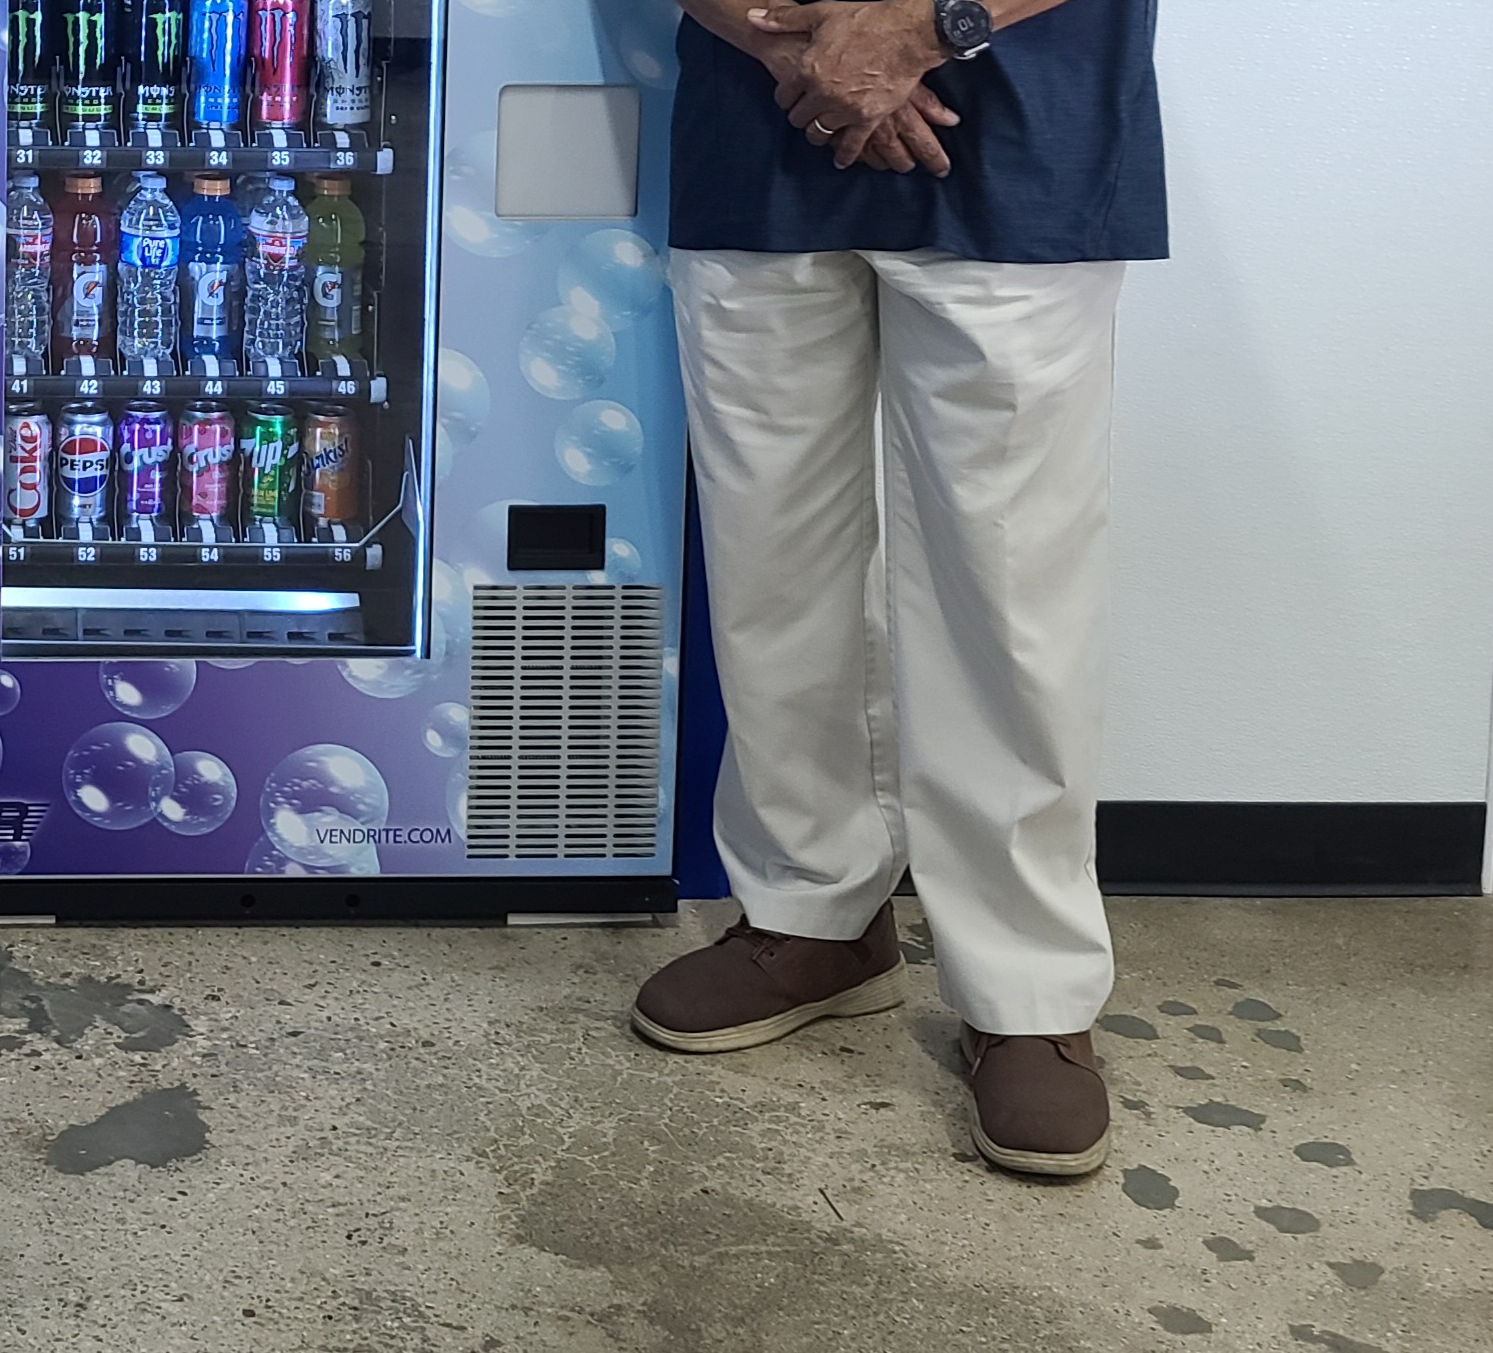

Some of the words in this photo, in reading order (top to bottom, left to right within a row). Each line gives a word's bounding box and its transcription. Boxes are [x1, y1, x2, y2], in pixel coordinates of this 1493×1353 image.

[17, 151, 33, 163] 31
[83, 152, 101, 164] 32
[146, 152, 165, 164] 33
[209, 153, 227, 165] 34
[271, 153, 289, 165] 35
[336, 153, 354, 166] 36
[143, 238, 165, 248] Pure
[73, 272, 103, 308] G
[198, 271, 227, 306] G
[313, 272, 341, 308] G
[11, 380, 28, 392] 41
[79, 380, 98, 394] 42
[143, 380, 161, 394] 43
[205, 381, 223, 394] 44
[267, 381, 285, 394] 45
[337, 382, 356, 394] 46
[7, 422, 43, 518] Coke
[9, 548, 25, 560] 51
[77, 548, 95, 561] 52
[139, 548, 157, 561] 53
[201, 548, 219, 562] 54
[263, 548, 281, 562] 55
[334, 548, 351, 560] 56
[315, 828, 452, 844] VENDRITE.COM
